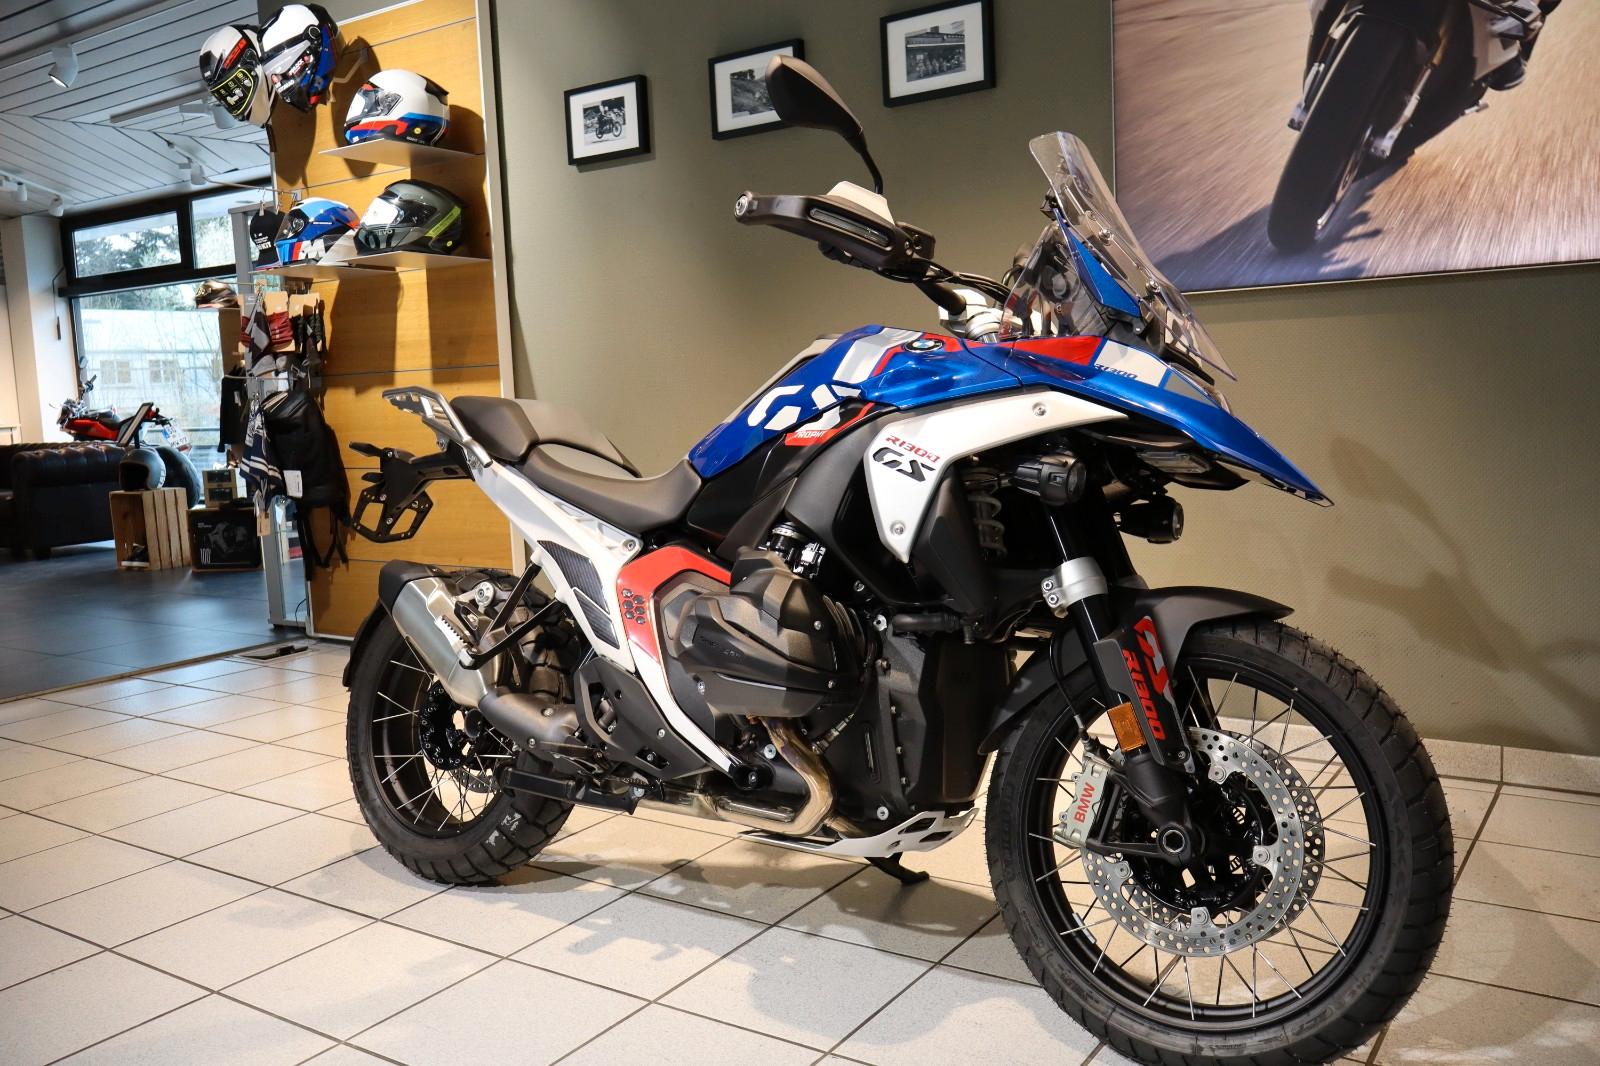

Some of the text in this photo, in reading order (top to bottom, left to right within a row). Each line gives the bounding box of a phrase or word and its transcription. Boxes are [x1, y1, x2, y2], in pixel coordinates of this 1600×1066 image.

[872, 447, 936, 482] GS
[885, 435, 940, 463] R1300
[1121, 648, 1167, 741] R1300
[1073, 782, 1096, 823] BMW
